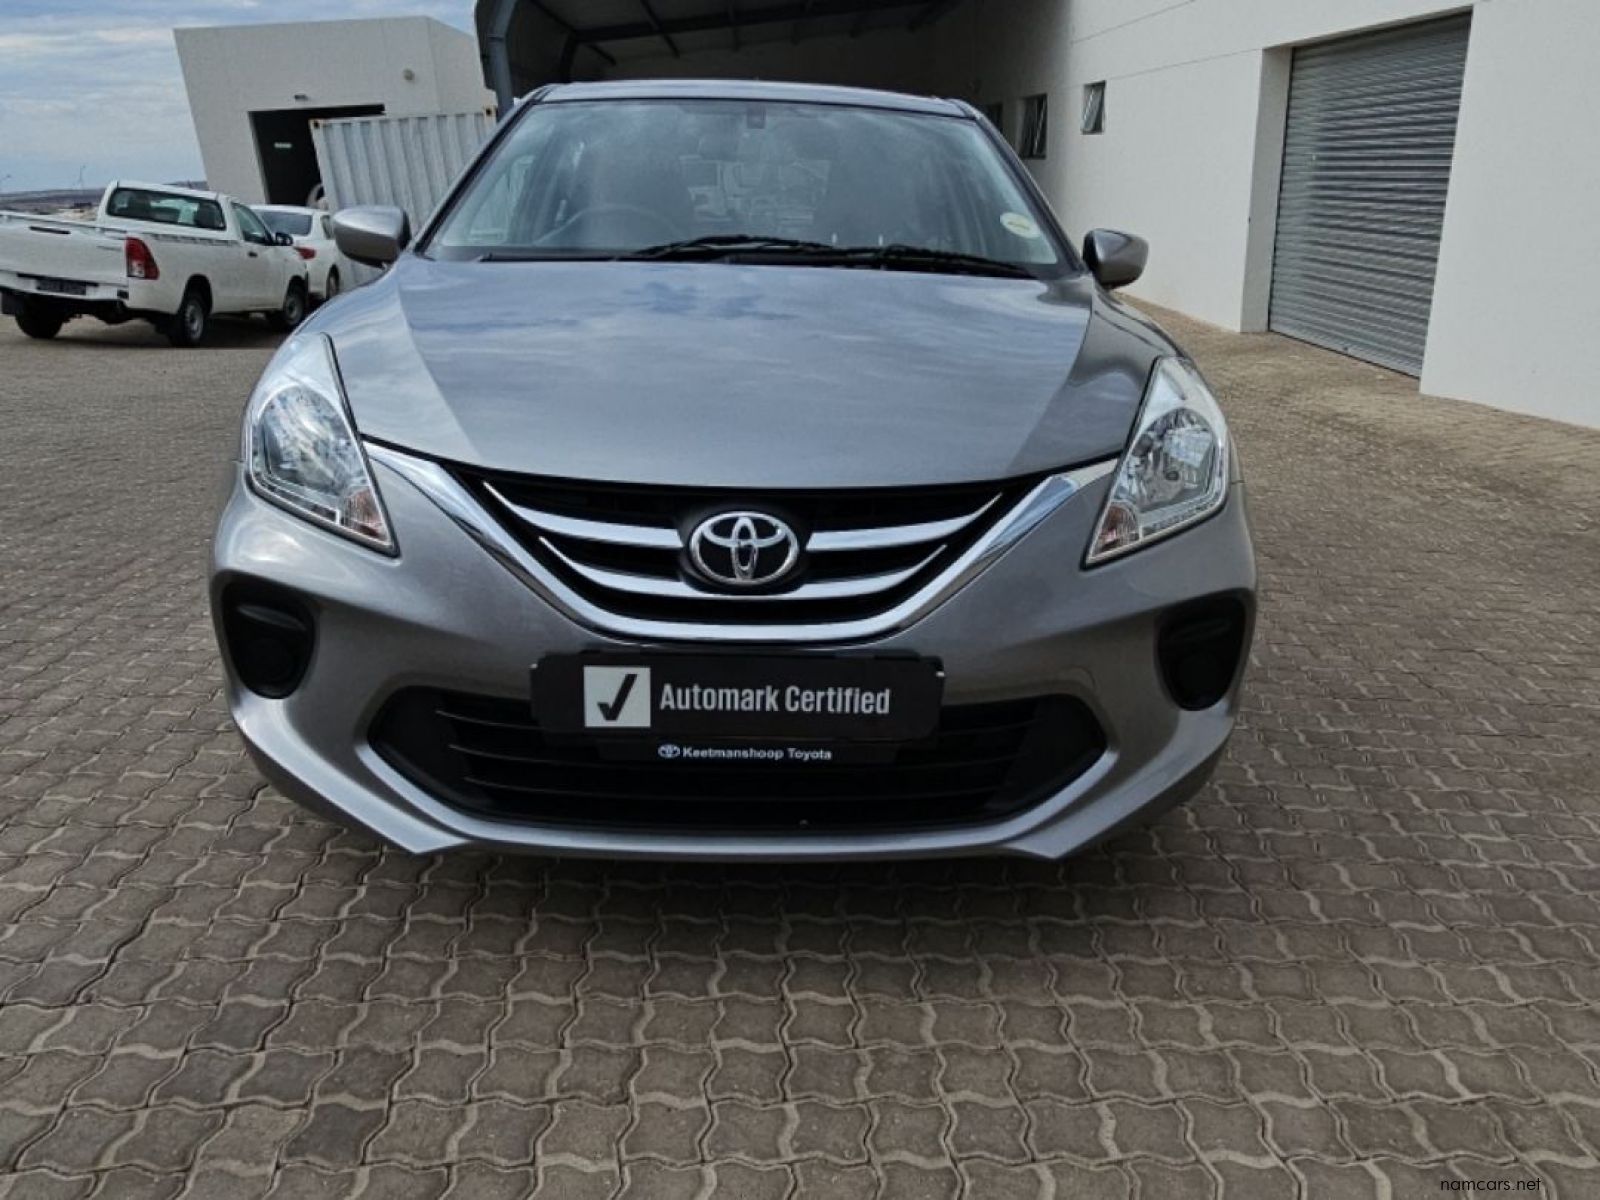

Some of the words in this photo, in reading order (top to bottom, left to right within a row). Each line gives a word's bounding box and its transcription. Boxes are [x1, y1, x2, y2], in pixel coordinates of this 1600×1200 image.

[660, 683, 780, 711] Automark
[784, 685, 890, 714] Certified
[682, 747, 784, 760] Keetmanshoop
[787, 747, 832, 761] Toyota
